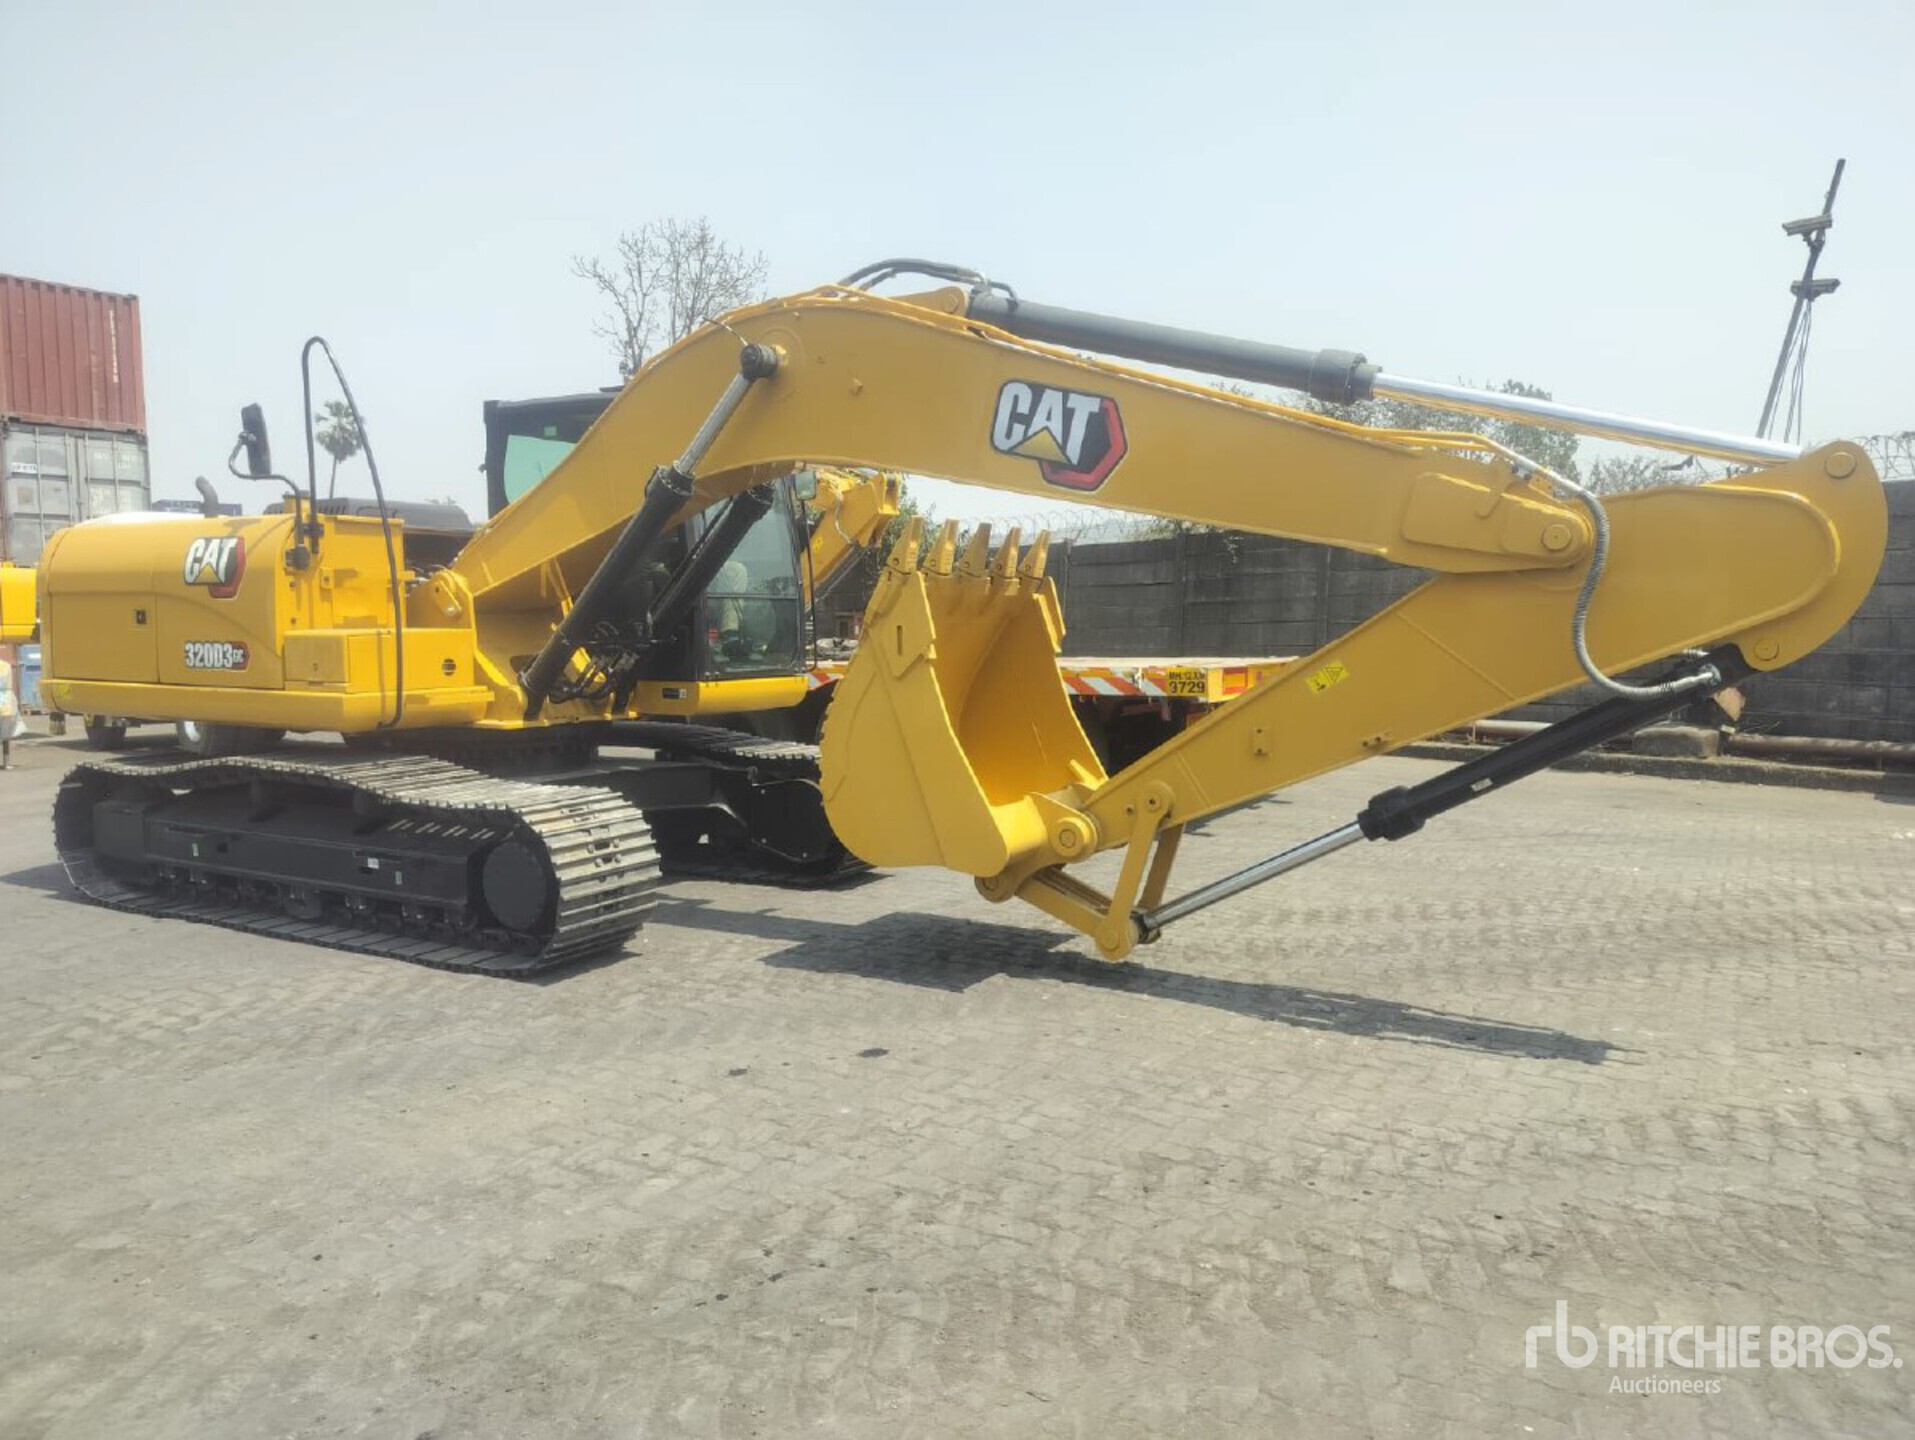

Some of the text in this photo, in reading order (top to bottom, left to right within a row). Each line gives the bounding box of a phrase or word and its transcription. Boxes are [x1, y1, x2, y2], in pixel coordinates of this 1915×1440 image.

[991, 382, 1101, 466] CAT
[184, 538, 238, 584] CAT
[185, 643, 233, 668] 320D3
[1169, 681, 1206, 694] 3729
